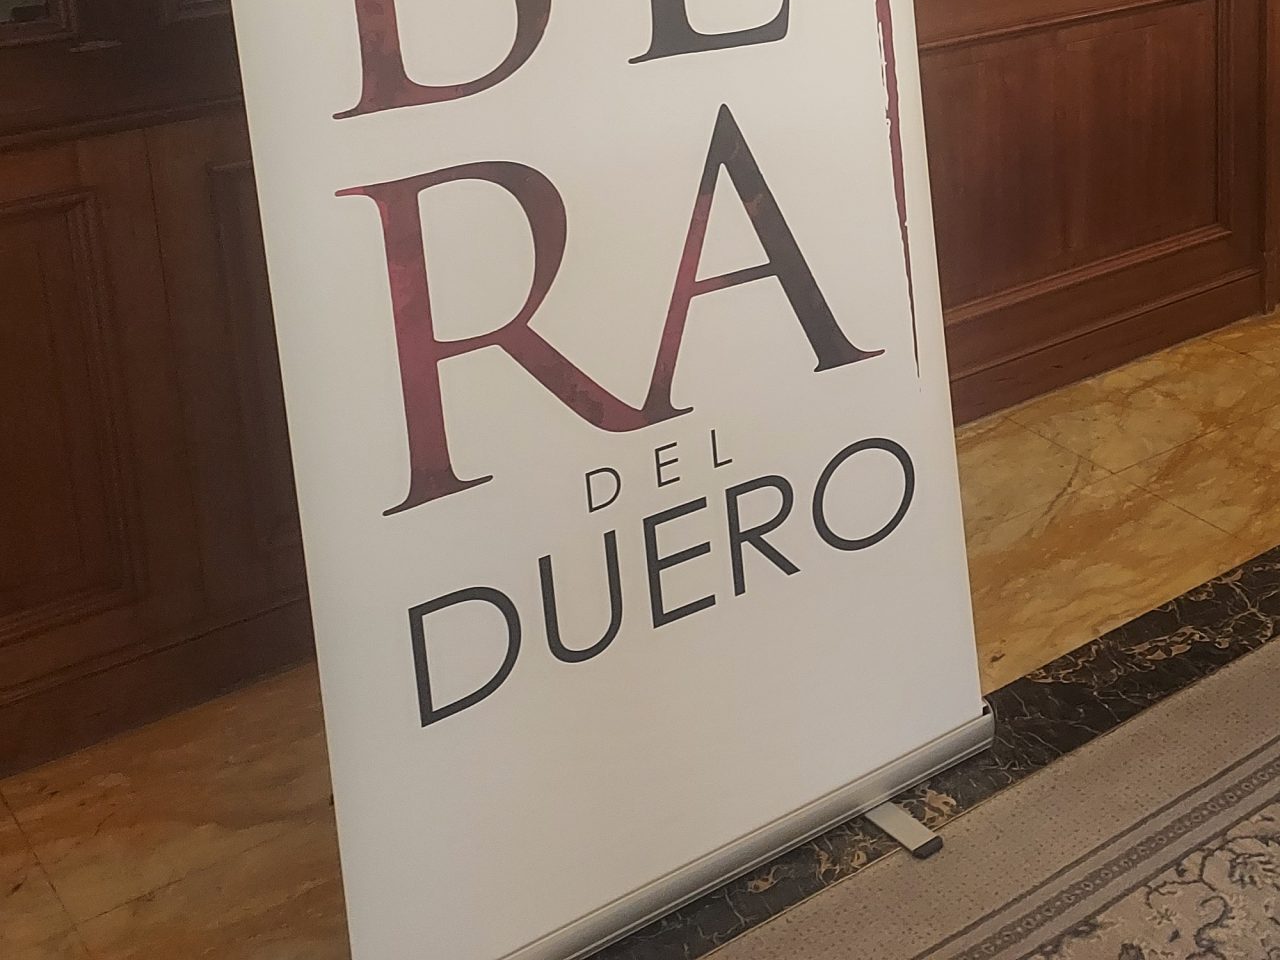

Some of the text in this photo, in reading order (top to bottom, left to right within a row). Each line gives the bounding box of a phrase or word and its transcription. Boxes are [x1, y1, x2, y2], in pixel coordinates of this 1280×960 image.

[334, 103, 886, 517] RA
[407, 436, 916, 729] DUERO
[584, 428, 733, 514] DEL
